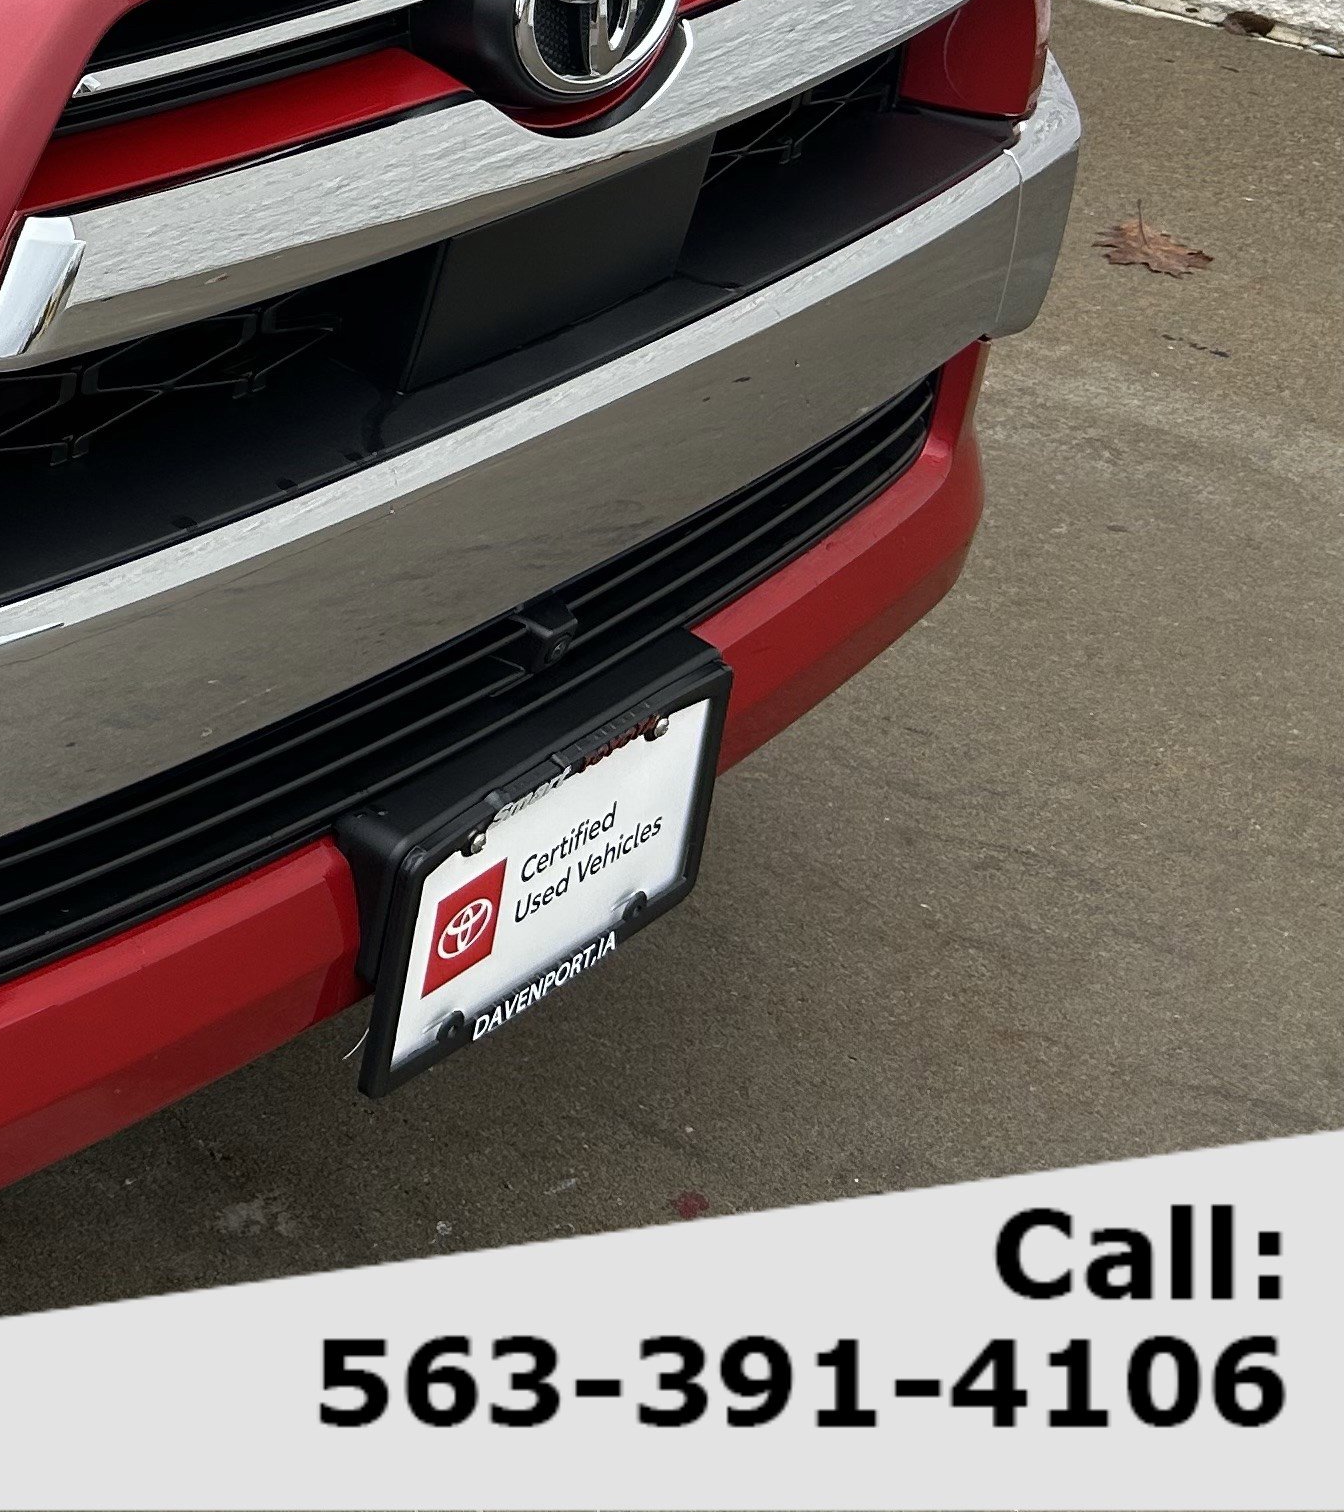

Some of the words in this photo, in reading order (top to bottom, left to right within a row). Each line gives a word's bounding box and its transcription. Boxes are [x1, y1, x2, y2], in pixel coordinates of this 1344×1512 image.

[514, 868, 570, 923] Used
[576, 816, 663, 885] Vehicles
[520, 801, 618, 882] Certified
[472, 930, 616, 1041] DAVENPORT,IA
